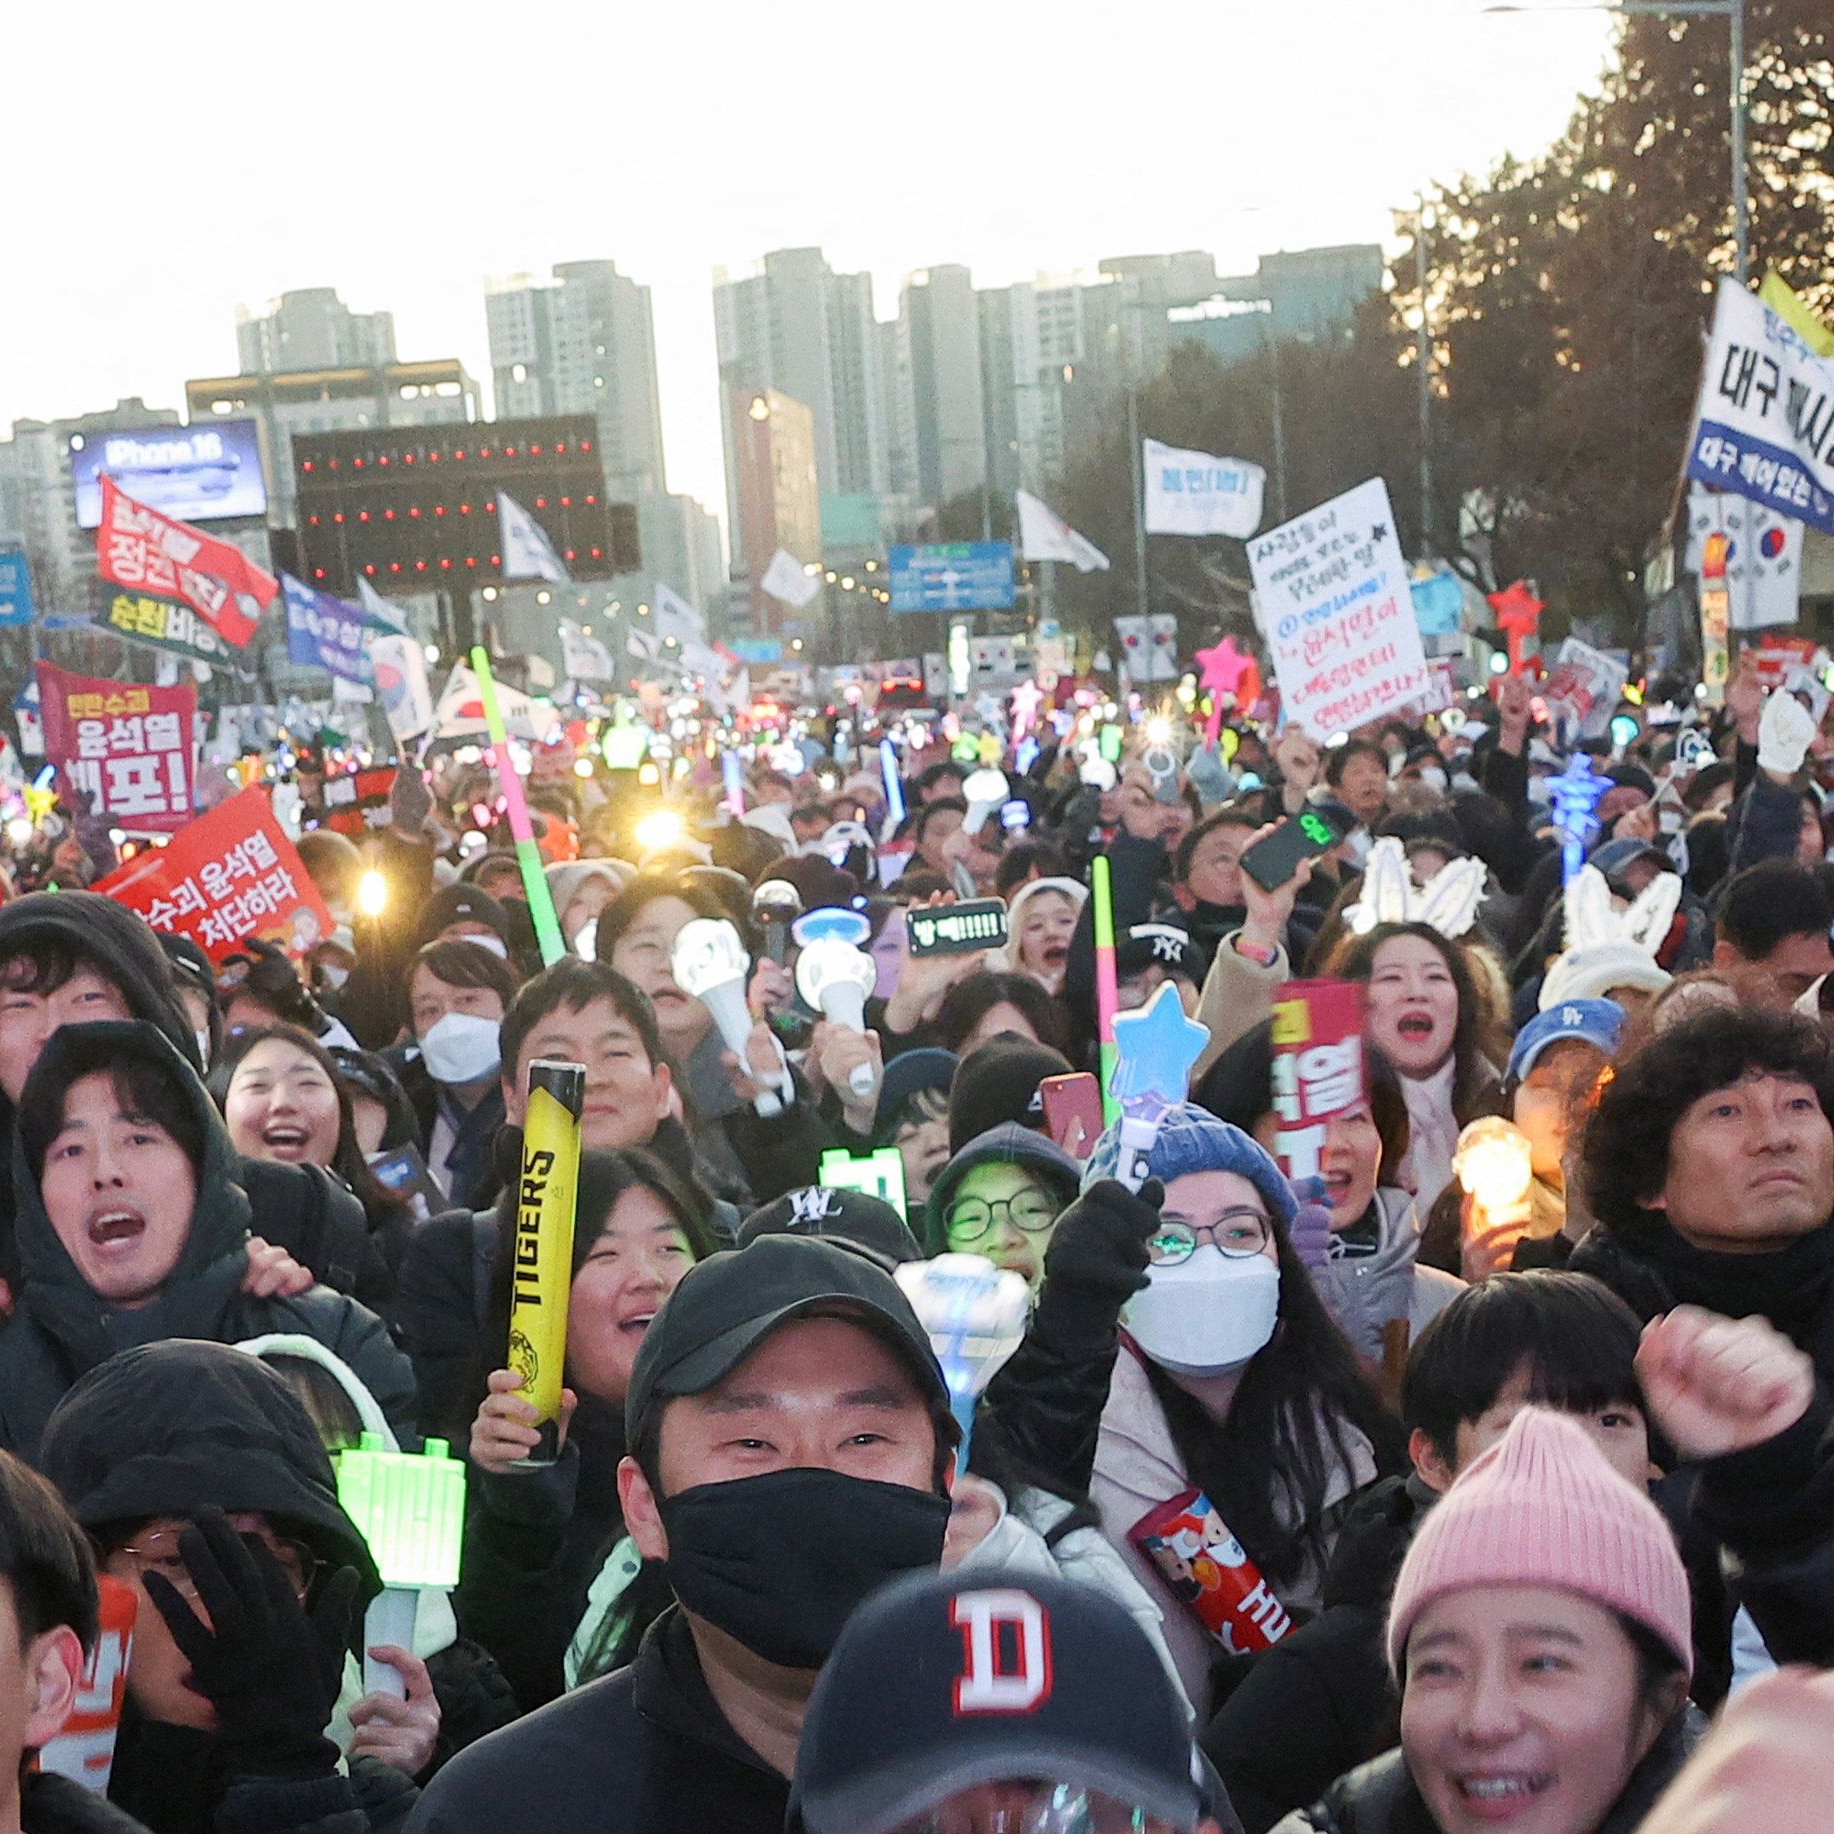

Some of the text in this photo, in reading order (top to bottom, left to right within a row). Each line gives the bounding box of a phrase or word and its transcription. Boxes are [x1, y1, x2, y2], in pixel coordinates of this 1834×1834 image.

[1719, 343, 1780, 417] 대구
[77, 712, 182, 758] 윤석열
[200, 830, 279, 901] 윤석열
[197, 866, 298, 948] 처단하라
[511, 1144, 555, 1316] TIGERS
[951, 1589, 1052, 1716] D
